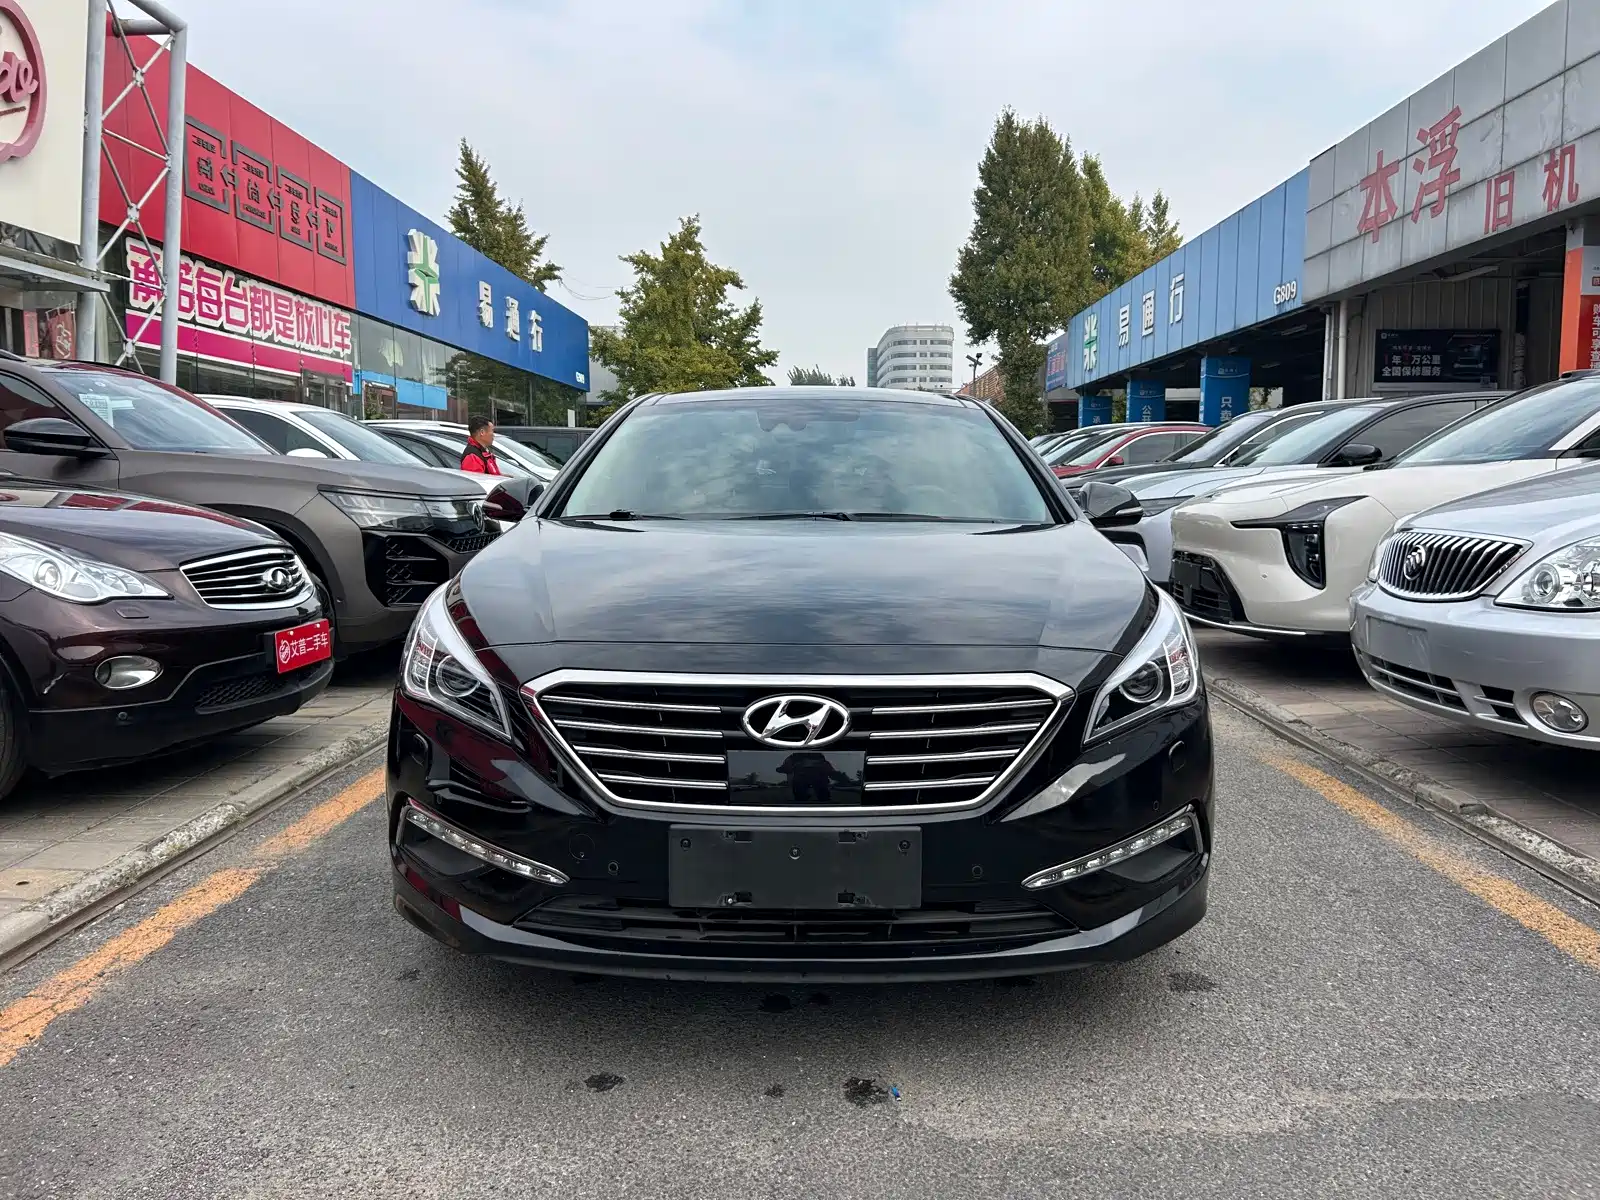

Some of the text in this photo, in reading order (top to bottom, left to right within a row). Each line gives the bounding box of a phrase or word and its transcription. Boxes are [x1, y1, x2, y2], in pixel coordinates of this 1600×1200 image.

[1357, 105, 1463, 243] 本浮
[1118, 272, 1185, 348] 易通行
[1273, 280, 1297, 305] G809
[290, 632, 329, 658] 艾普二手车
